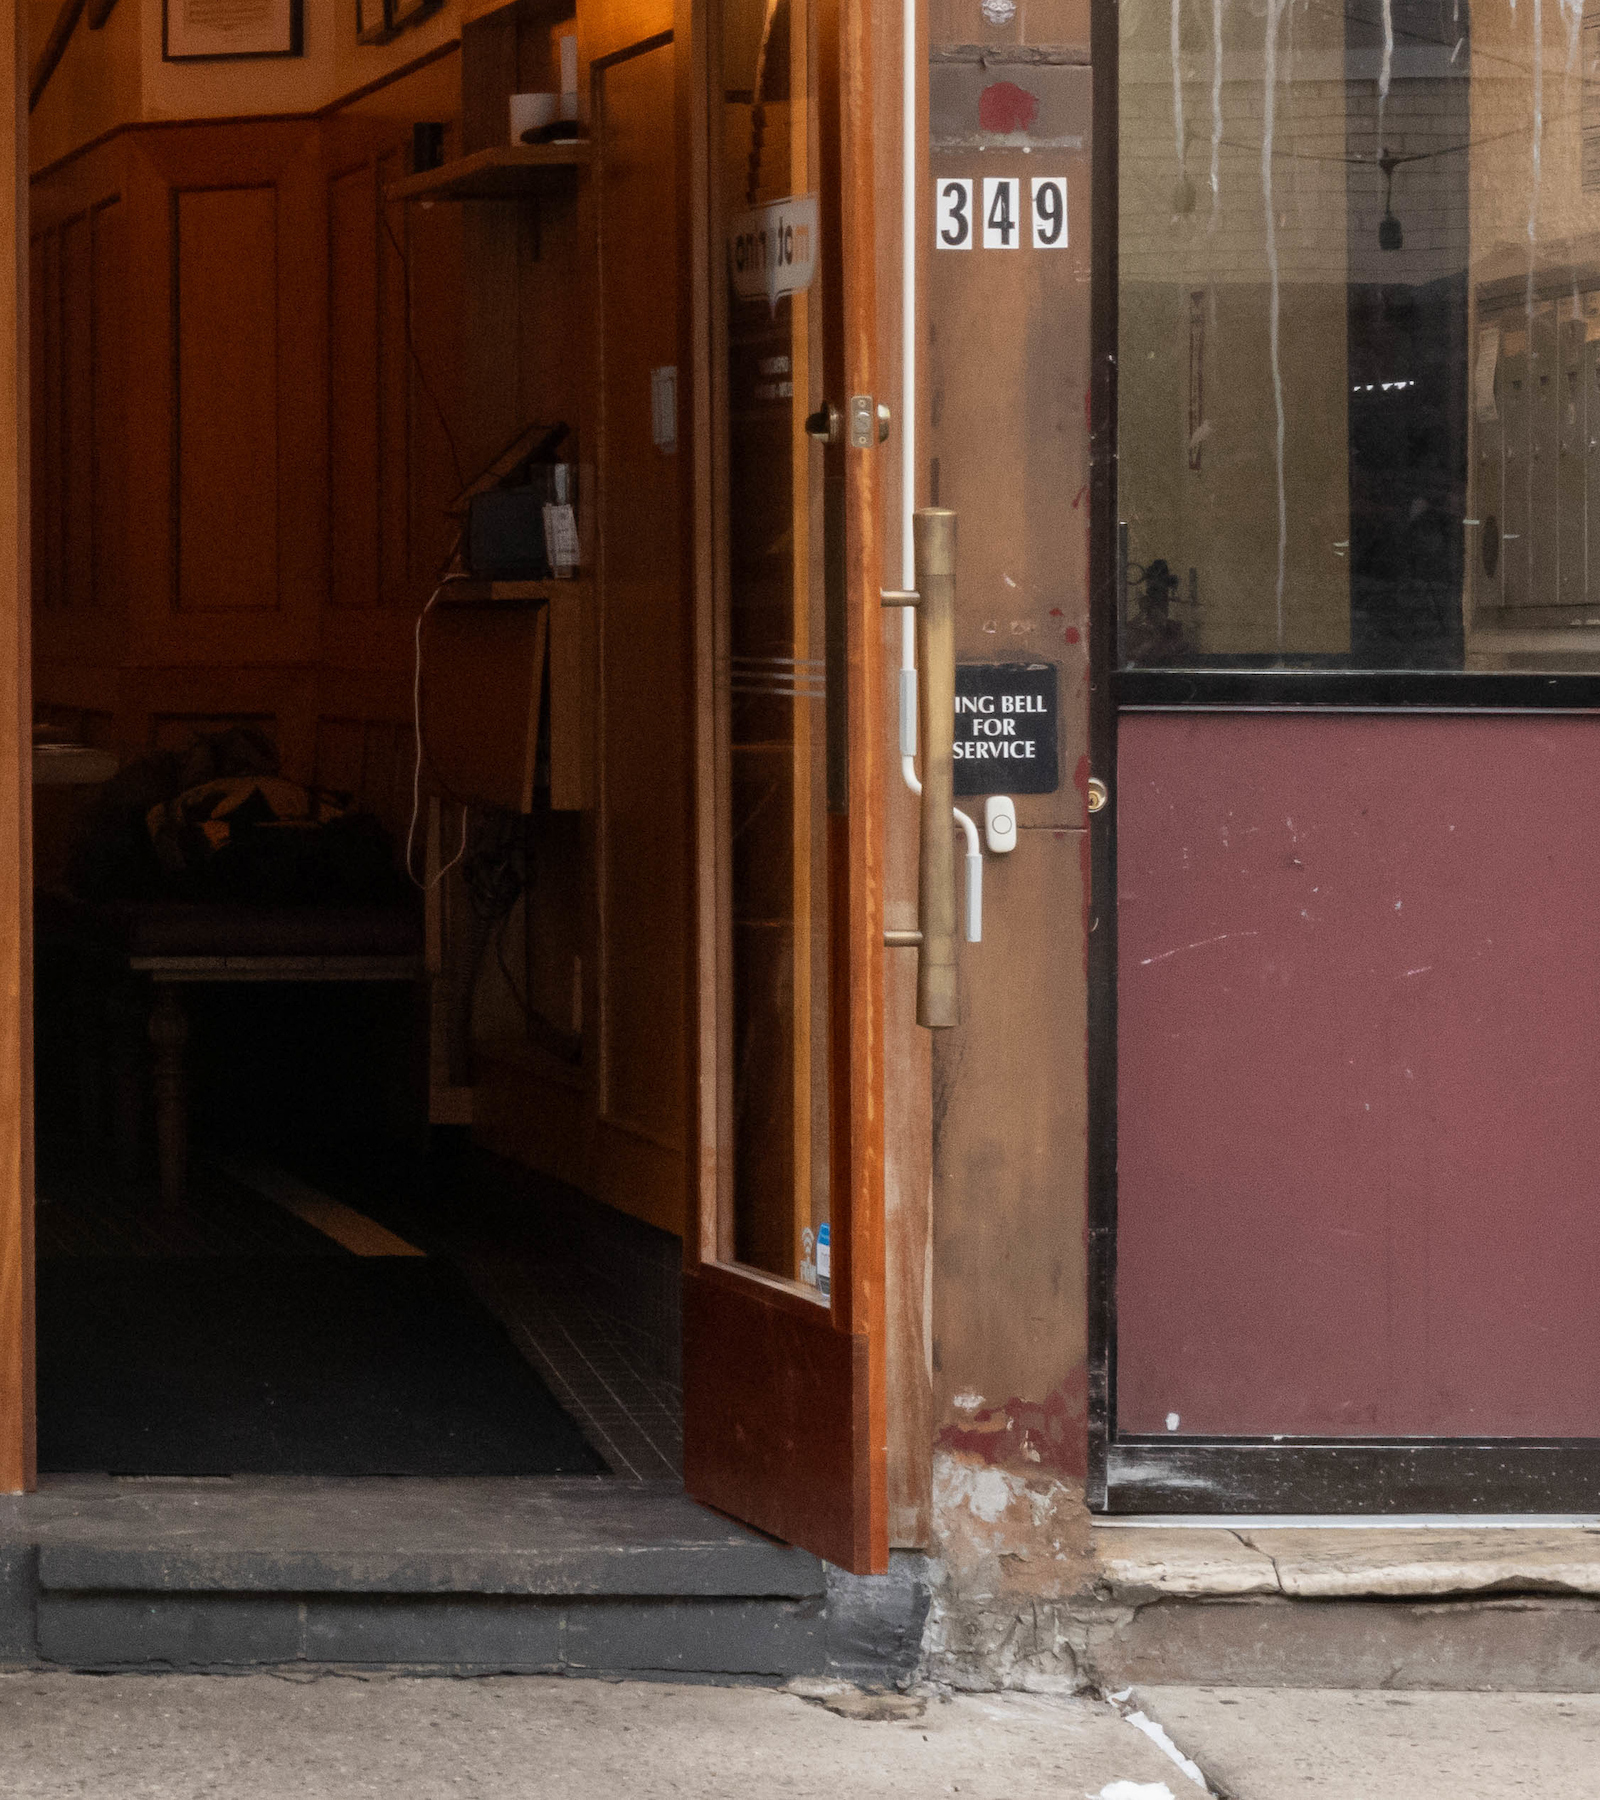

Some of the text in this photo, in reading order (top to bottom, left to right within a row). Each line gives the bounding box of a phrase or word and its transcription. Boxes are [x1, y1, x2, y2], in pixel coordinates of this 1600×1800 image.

[941, 181, 1063, 246] 349
[954, 695, 1047, 713] ING BELL
[972, 718, 1016, 736] FOR
[952, 740, 1036, 759] SERVICE
